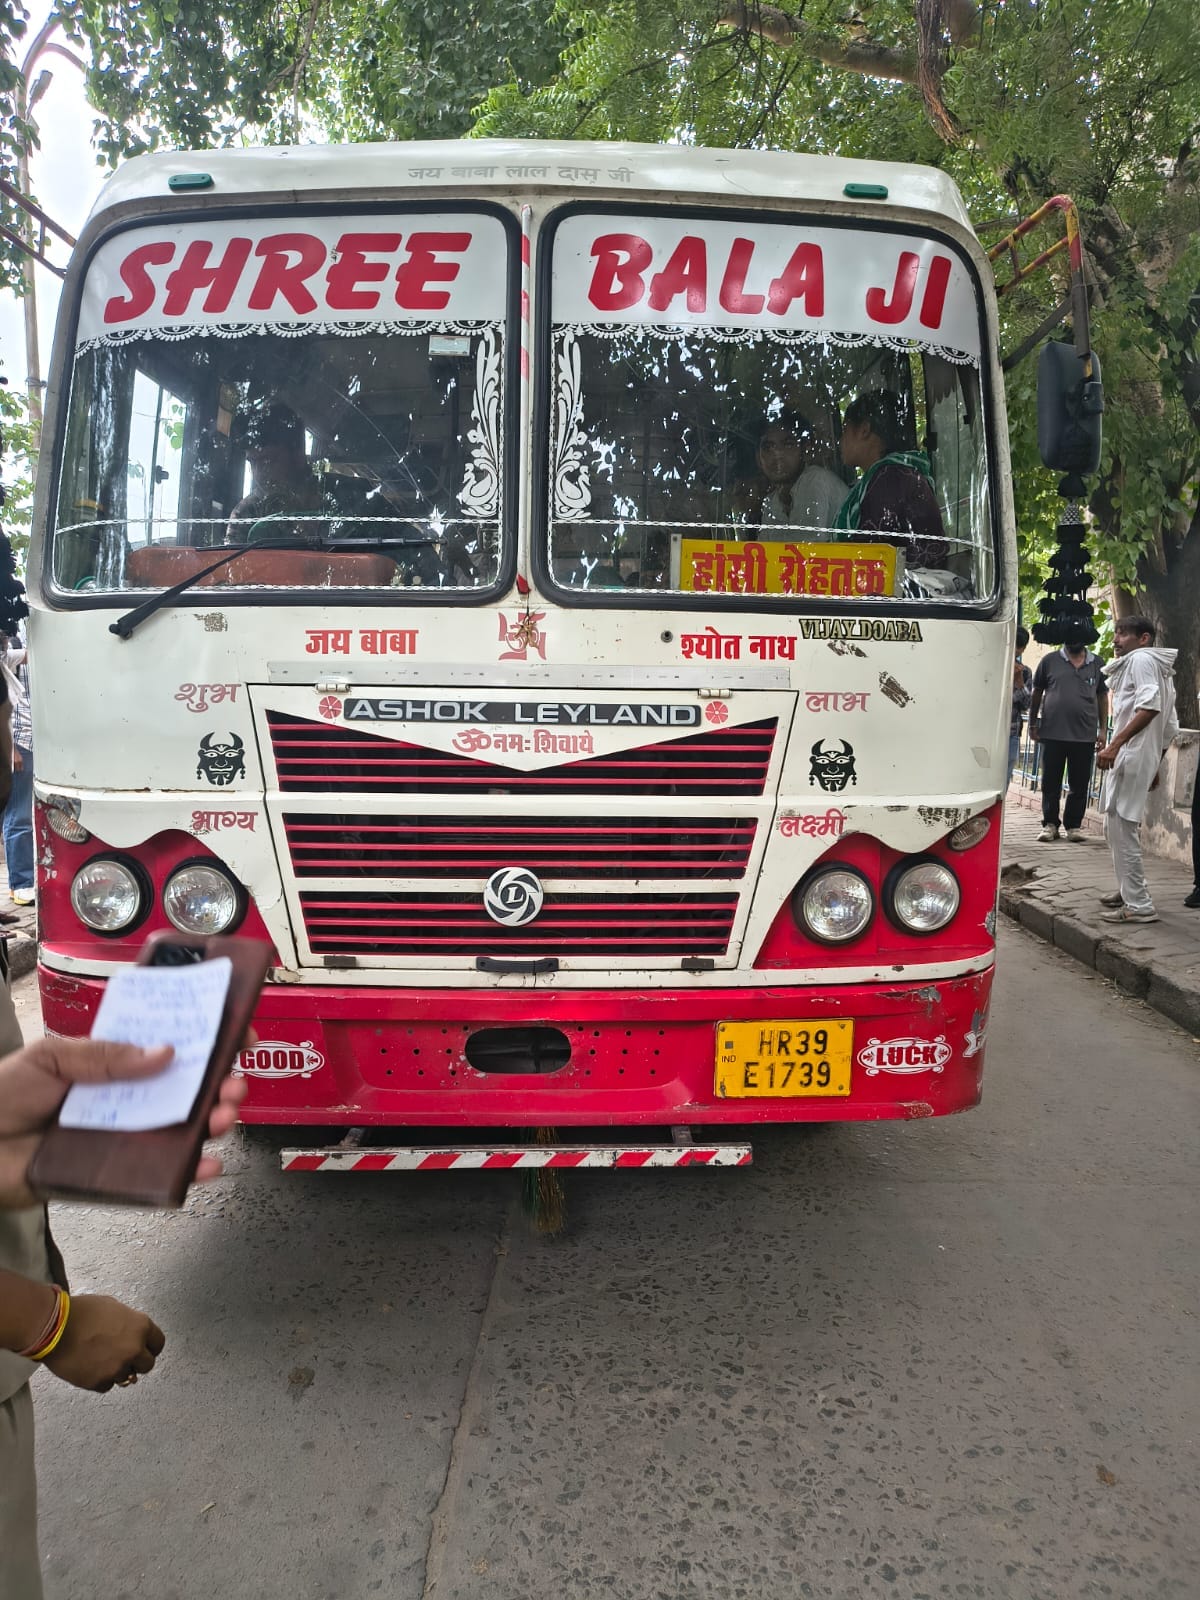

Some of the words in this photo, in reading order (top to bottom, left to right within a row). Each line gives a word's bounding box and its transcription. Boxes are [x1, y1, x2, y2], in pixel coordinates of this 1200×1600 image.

[408, 167, 444, 179] जय
[505, 165, 550, 178] लाल
[608, 167, 634, 183] जी
[104, 232, 472, 324] SHREE
[588, 233, 824, 317] BALA
[866, 251, 952, 329] JI
[692, 543, 768, 592] हांसी
[779, 544, 887, 596] रोहतक
[305, 630, 352, 654] जय
[359, 630, 419, 654] बाबा
[799, 618, 857, 639] VIJAY
[681, 626, 742, 660] श्योत
[748, 636, 797, 660] नाथ
[174, 683, 241, 713] शुभ
[805, 691, 871, 712] लाभ
[350, 699, 488, 721] ASHOK
[515, 703, 696, 726] LEYLAND
[780, 808, 848, 838] लक्ष्मी
[759, 1029, 828, 1056] HR39
[876, 1045, 939, 1067] LUCK
[240, 1050, 305, 1070] GOOD
[721, 1055, 736, 1063] IND
[744, 1061, 831, 1088] E1739
